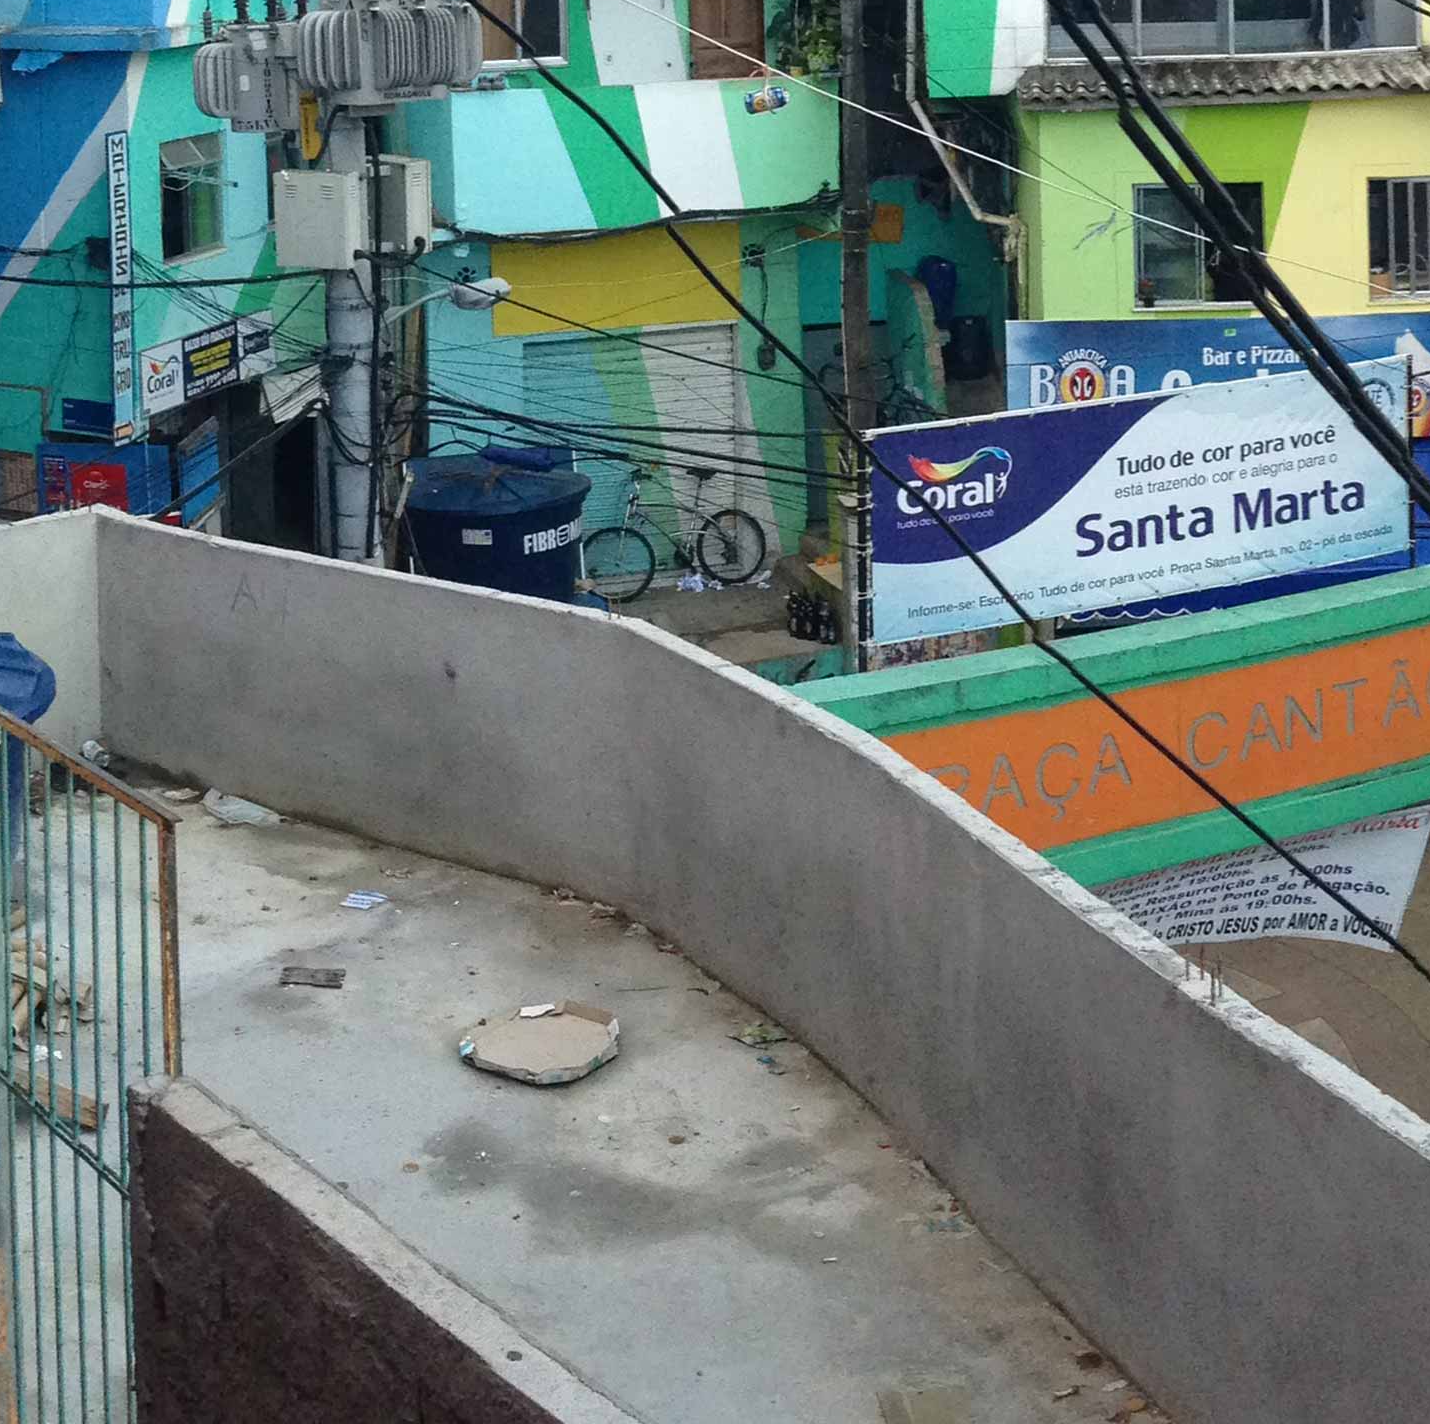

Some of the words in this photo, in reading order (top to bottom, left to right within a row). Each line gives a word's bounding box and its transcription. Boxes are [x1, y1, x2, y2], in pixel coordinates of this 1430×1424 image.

[111, 137, 129, 277] MATERIAIS
[1058, 347, 1108, 369] ANTARCTICA
[1202, 347, 1231, 366] Bar
[1235, 351, 1246, 365] e
[147, 369, 176, 394] Coral
[1116, 454, 1166, 477] Tudo
[1170, 449, 1195, 469] de
[1202, 443, 1234, 464] cor
[1239, 435, 1285, 463] para
[1289, 424, 1337, 449] você
[1114, 480, 1145, 500] está
[1146, 473, 1207, 496] trazendo
[1212, 467, 1237, 484] cor
[1239, 467, 1249, 481] e
[1251, 458, 1295, 480] alegria
[1297, 452, 1327, 472] para
[1328, 451, 1338, 464] o
[896, 473, 995, 515] Coral
[1075, 504, 1216, 559] Santa
[1232, 478, 1367, 535] Marta
[907, 599, 977, 619] Informe-se:
[1039, 585, 1068, 599] Tudo
[1070, 581, 1086, 593] de
[1088, 578, 1108, 590] cor
[1109, 573, 1136, 589] para
[1138, 566, 1166, 581] você
[1170, 559, 1203, 575] Praça
[1338, 531, 1353, 544] da
[1354, 524, 1394, 542] escada
[1146, 877, 1256, 907] Ressurreição
[1222, 887, 1270, 902] Ponto
[1276, 880, 1298, 892] de
[1174, 907, 1215, 921] Mina
[1245, 893, 1319, 911] 19:00hs.
[1165, 919, 1215, 941] CRISTO
[1216, 915, 1260, 935] JESUS
[1262, 916, 1285, 934] por
[1286, 912, 1329, 931] AMOR
[1329, 919, 1340, 932] a
